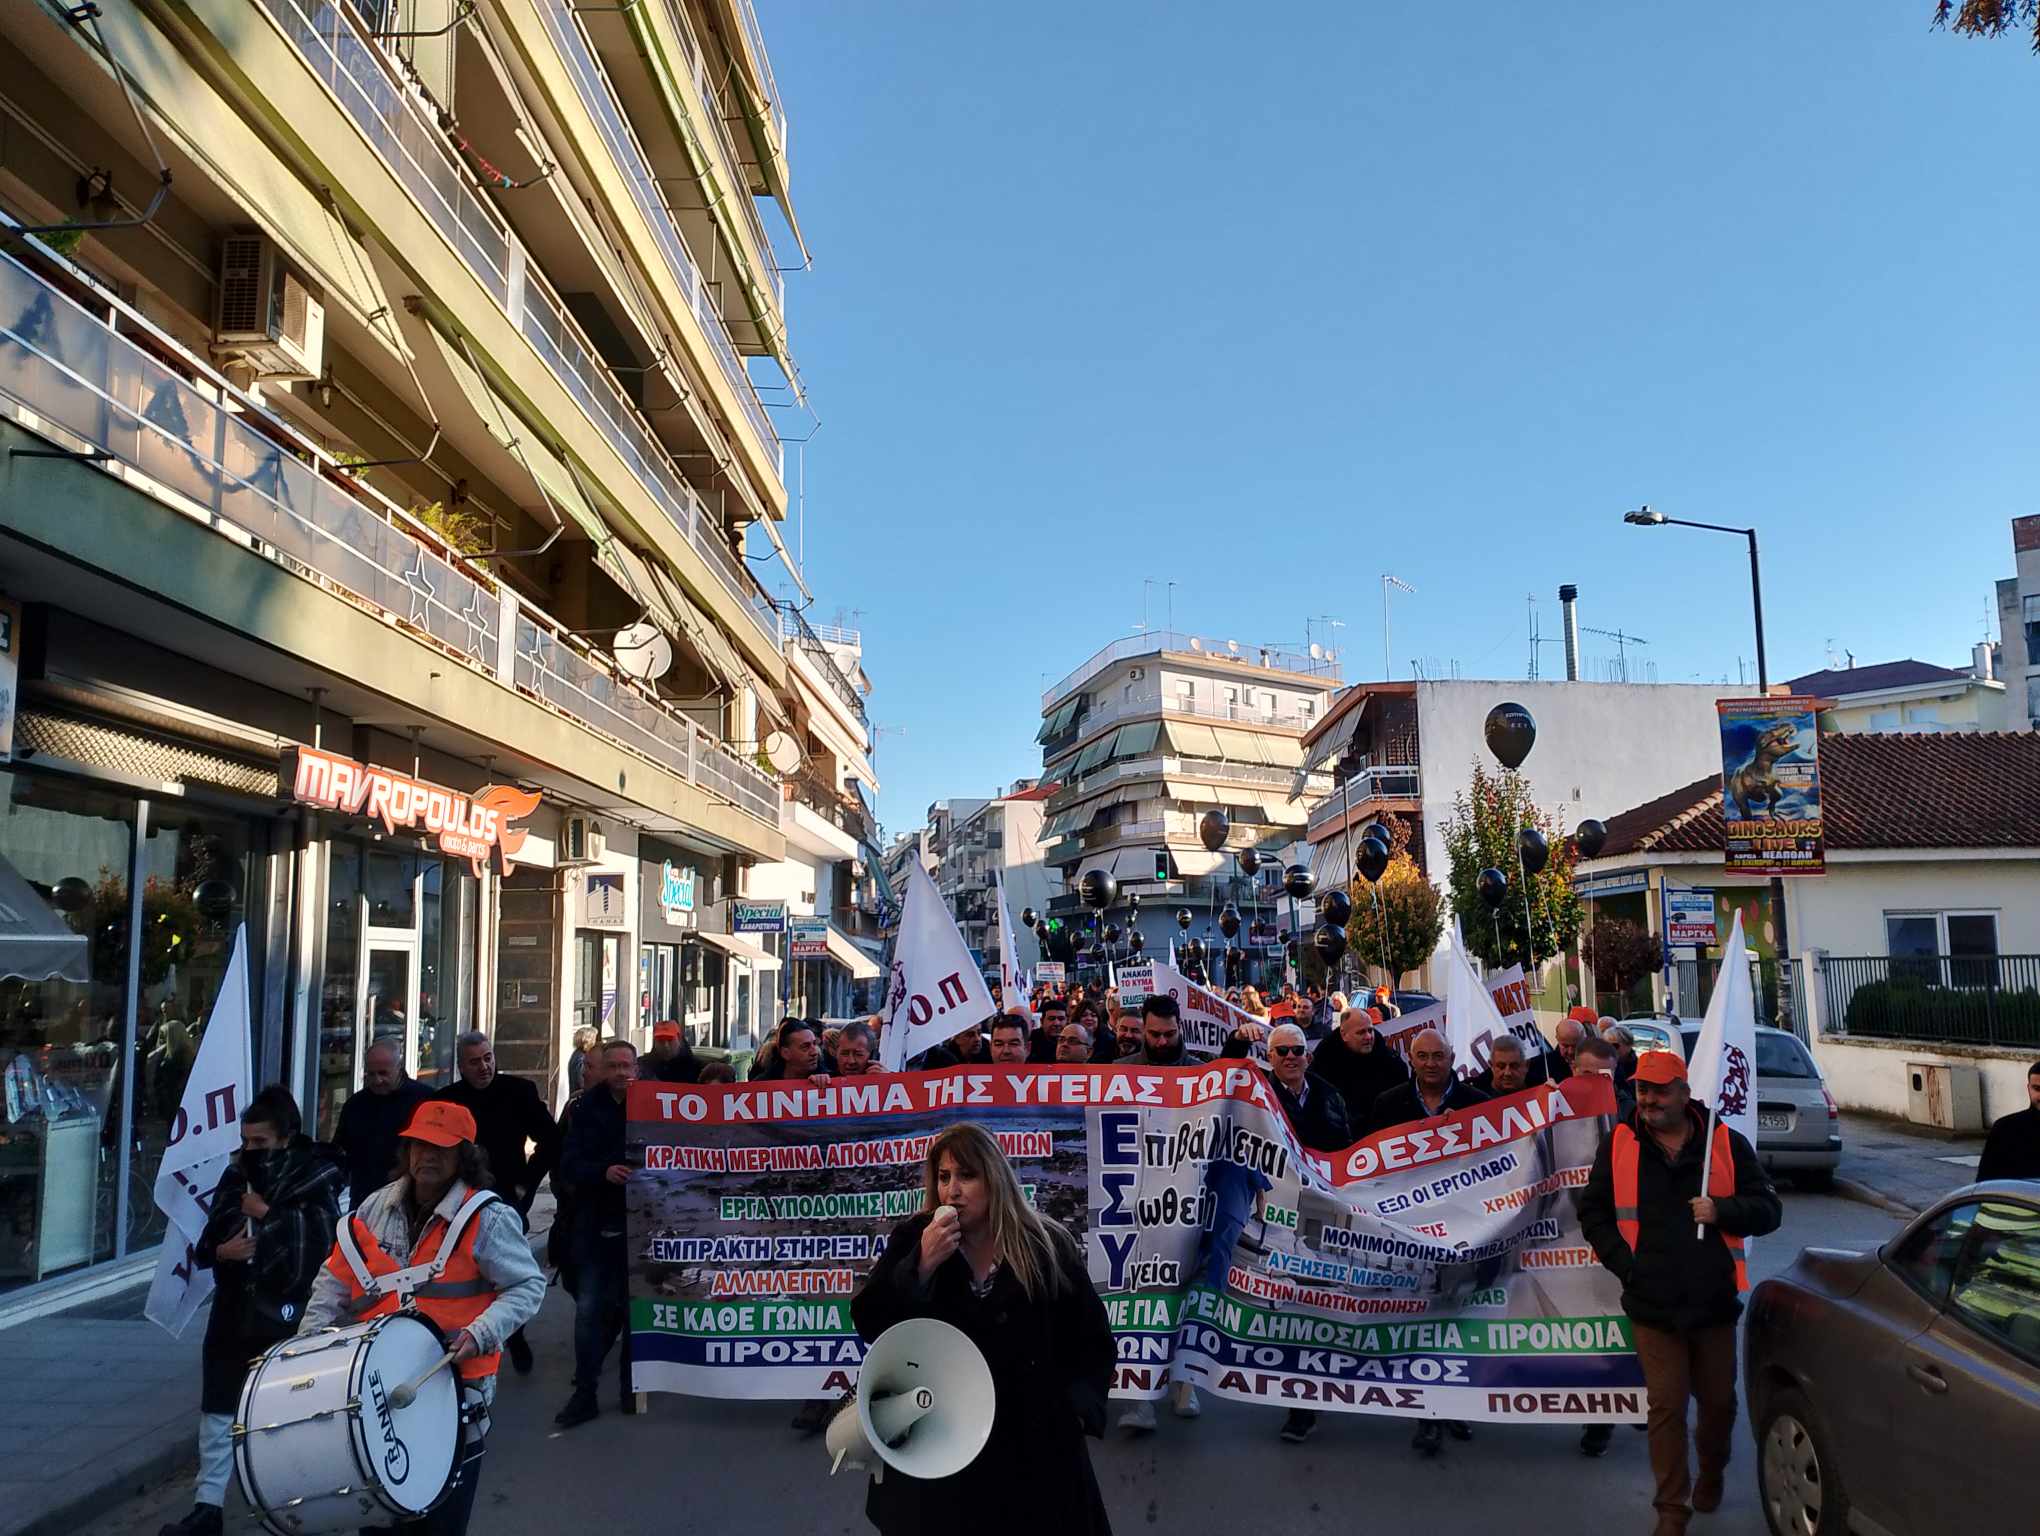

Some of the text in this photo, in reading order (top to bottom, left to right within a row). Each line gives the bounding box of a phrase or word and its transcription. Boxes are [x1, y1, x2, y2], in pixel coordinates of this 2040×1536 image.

[299, 752, 498, 841] MAVROPOULOS
[1727, 820, 1822, 839] DINOSAURS
[662, 859, 696, 916] Special
[736, 903, 784, 922] Special
[793, 945, 827, 953] ΜΑΡΓΚΑ
[1671, 930, 1714, 938] ΜΑΡΓΚΑ
[656, 1092, 708, 1121] ΤΟ
[723, 1082, 913, 1121] ΚΙΝΗΜΑ
[923, 1075, 994, 1107] ΤΗΣ
[1005, 1075, 1164, 1104] ΥΓΕΙΑΣ
[646, 1145, 726, 1172] ΚΡΑΤΙΚΗ
[729, 1144, 824, 1172] ΜΕΡΙΜΝΑ
[999, 1131, 1053, 1157] ΜΙΩΝ
[1346, 1089, 1575, 1178] ΘΕΣΣΑΛΙΑ
[1376, 1193, 1411, 1214] ΕΞΩ
[1412, 1186, 1430, 1204] ΟΙ
[1431, 1152, 1520, 1198] ΕΡΓΟΛΑΒΟΙ
[720, 1195, 771, 1221] ΕΡΓΑ
[771, 1192, 882, 1220] ΥΠΟΔΟΜΗΣ
[885, 1189, 911, 1217] ΚΑΙ
[1264, 1204, 1298, 1229] ΒΑΕ
[652, 1237, 770, 1262] ΕΜΠΡΑΚΤΗ
[775, 1235, 868, 1260] ΣΤΗΡΙΞΗ
[1322, 1226, 1458, 1263] ΜΟΝΙΜΟΠΟΙΗΣΗ
[1520, 1249, 1601, 1269] ΚΙΝΗΤΡΑ
[711, 1269, 853, 1296] ΑΛΛΗΛΕΓΓΥΗ
[1267, 1251, 1419, 1289] ΑΥΞΗΣΕΙΣ ΜΙΣΘΩΝ
[1228, 1266, 1430, 1316] ΟΧΙ ΣΤΗΝ ΙΔΙΩΤΙΚΟΠΟΙΗΣΗ
[652, 1303, 678, 1329] ΣΕ
[684, 1305, 755, 1332] ΚΑΘΕ
[762, 1305, 842, 1331] ΓΩΝΙΑ
[1132, 1299, 1170, 1326] ΓΙΑ
[1247, 1312, 1381, 1351] ΔΗΜΟΣΙΑ
[1387, 1322, 1464, 1351] ΥΓΕΙΑ
[1470, 1334, 1480, 1344] -
[1488, 1321, 1627, 1350] ΠΡΟΝΟΙΑ
[1231, 1341, 1285, 1367] ΤΟ
[1297, 1350, 1470, 1383] ΚΡΑΤΟΣ
[1218, 1369, 1426, 1411] ΑΓΩΝΑΣ
[1487, 1392, 1640, 1415] ΠΟΕΔΗΝ
